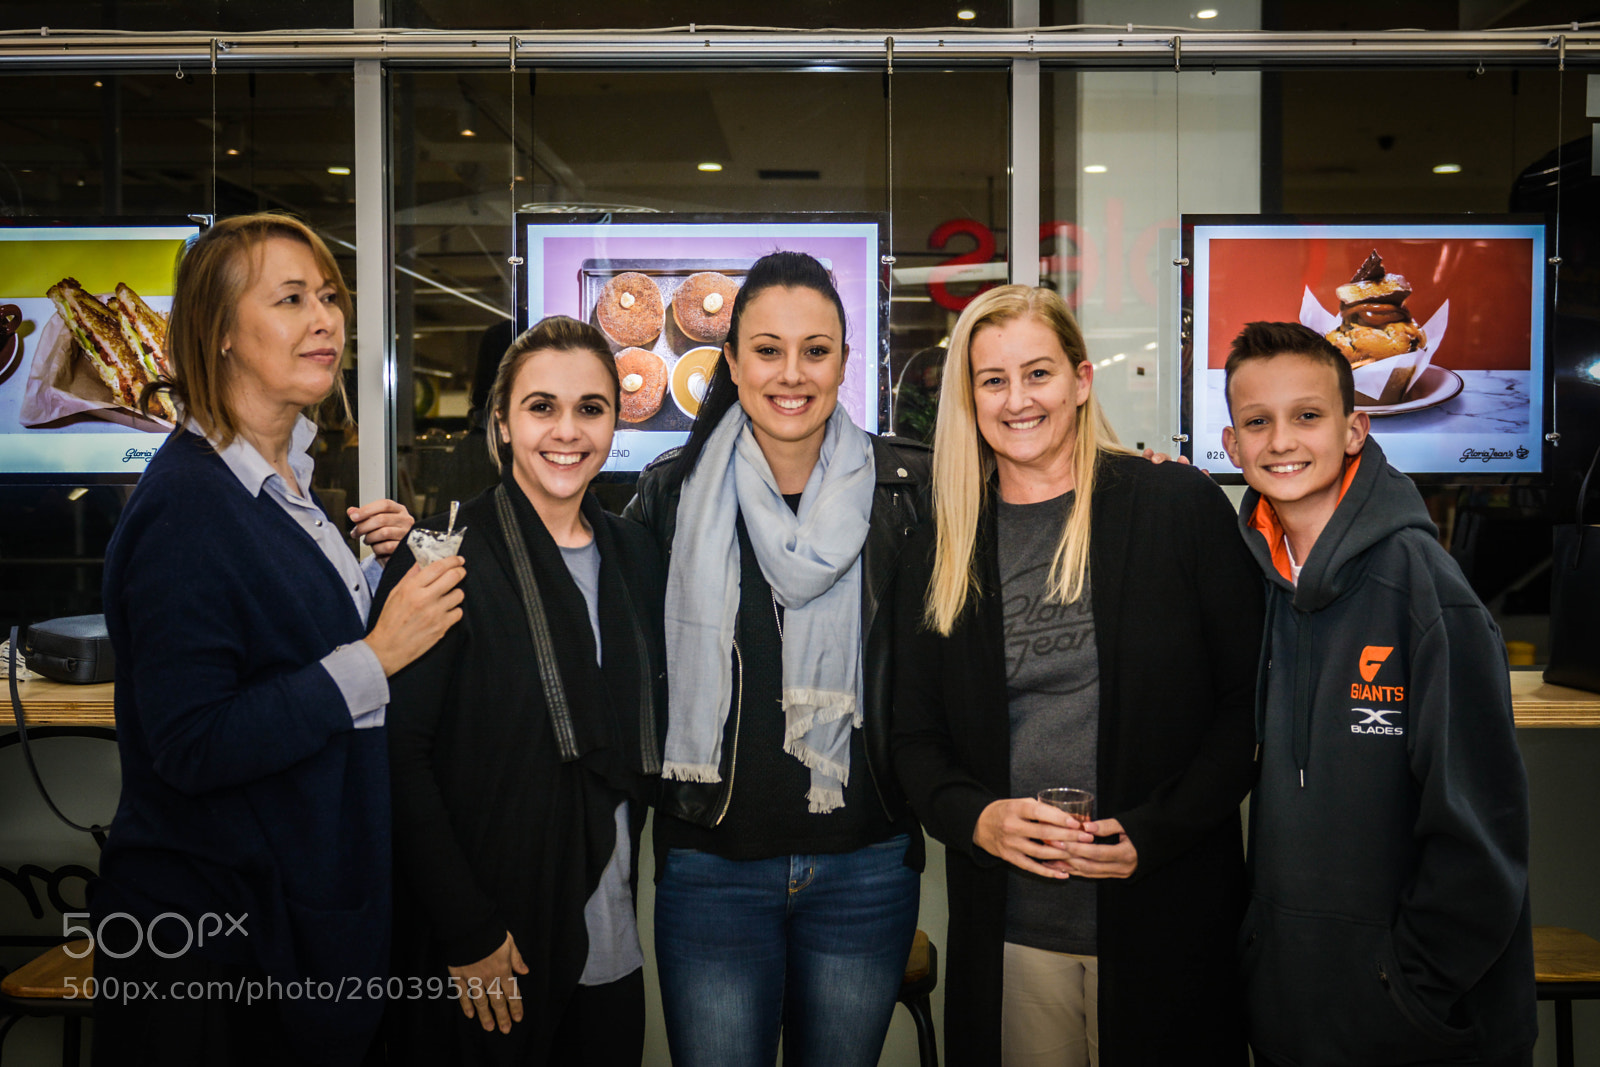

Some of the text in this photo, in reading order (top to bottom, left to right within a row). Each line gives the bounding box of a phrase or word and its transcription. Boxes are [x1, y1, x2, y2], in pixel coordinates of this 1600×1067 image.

[122, 448, 152, 462] Gloria
[1206, 451, 1225, 460] 026
[1459, 448, 1489, 463] Gloria
[1350, 682, 1404, 703] GIANTS
[1350, 724, 1404, 736] BLADES
